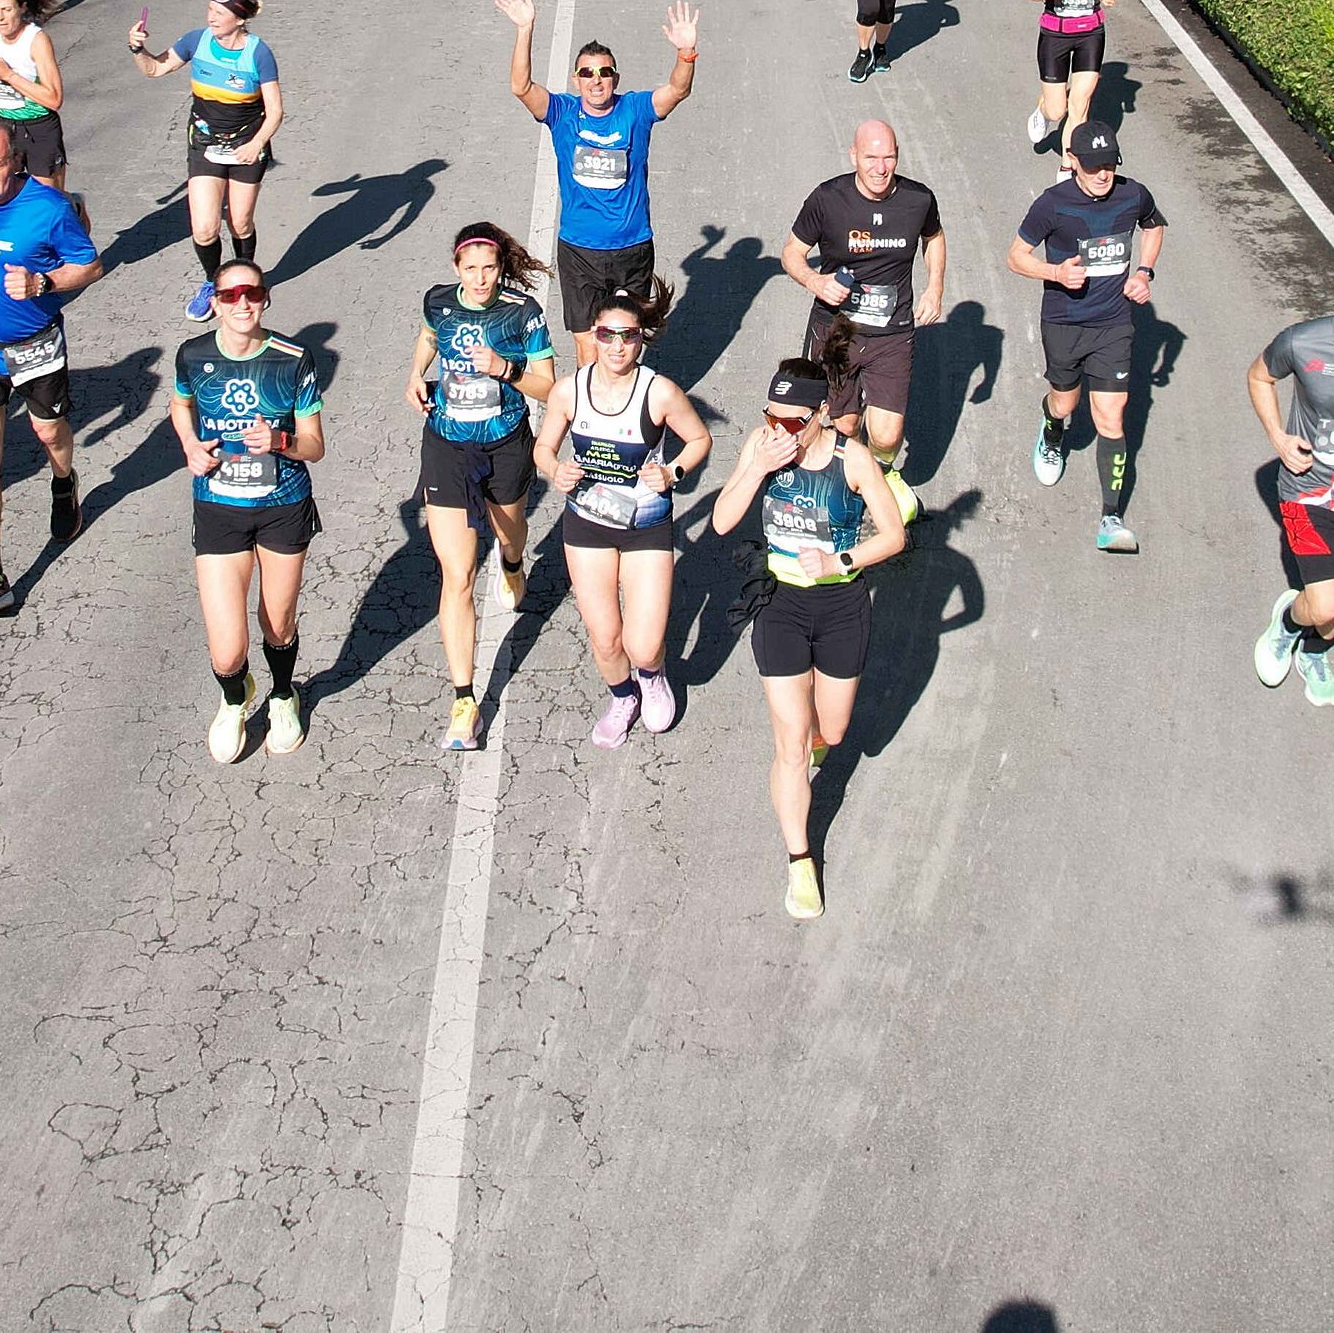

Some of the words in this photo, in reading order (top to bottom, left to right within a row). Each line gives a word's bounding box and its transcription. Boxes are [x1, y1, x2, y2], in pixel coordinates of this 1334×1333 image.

[848, 239, 907, 248] RUNNING
[1088, 243, 1125, 259] 5080
[851, 292, 889, 309] 5085
[14, 340, 55, 365] 5545
[220, 461, 263, 478] 4158
